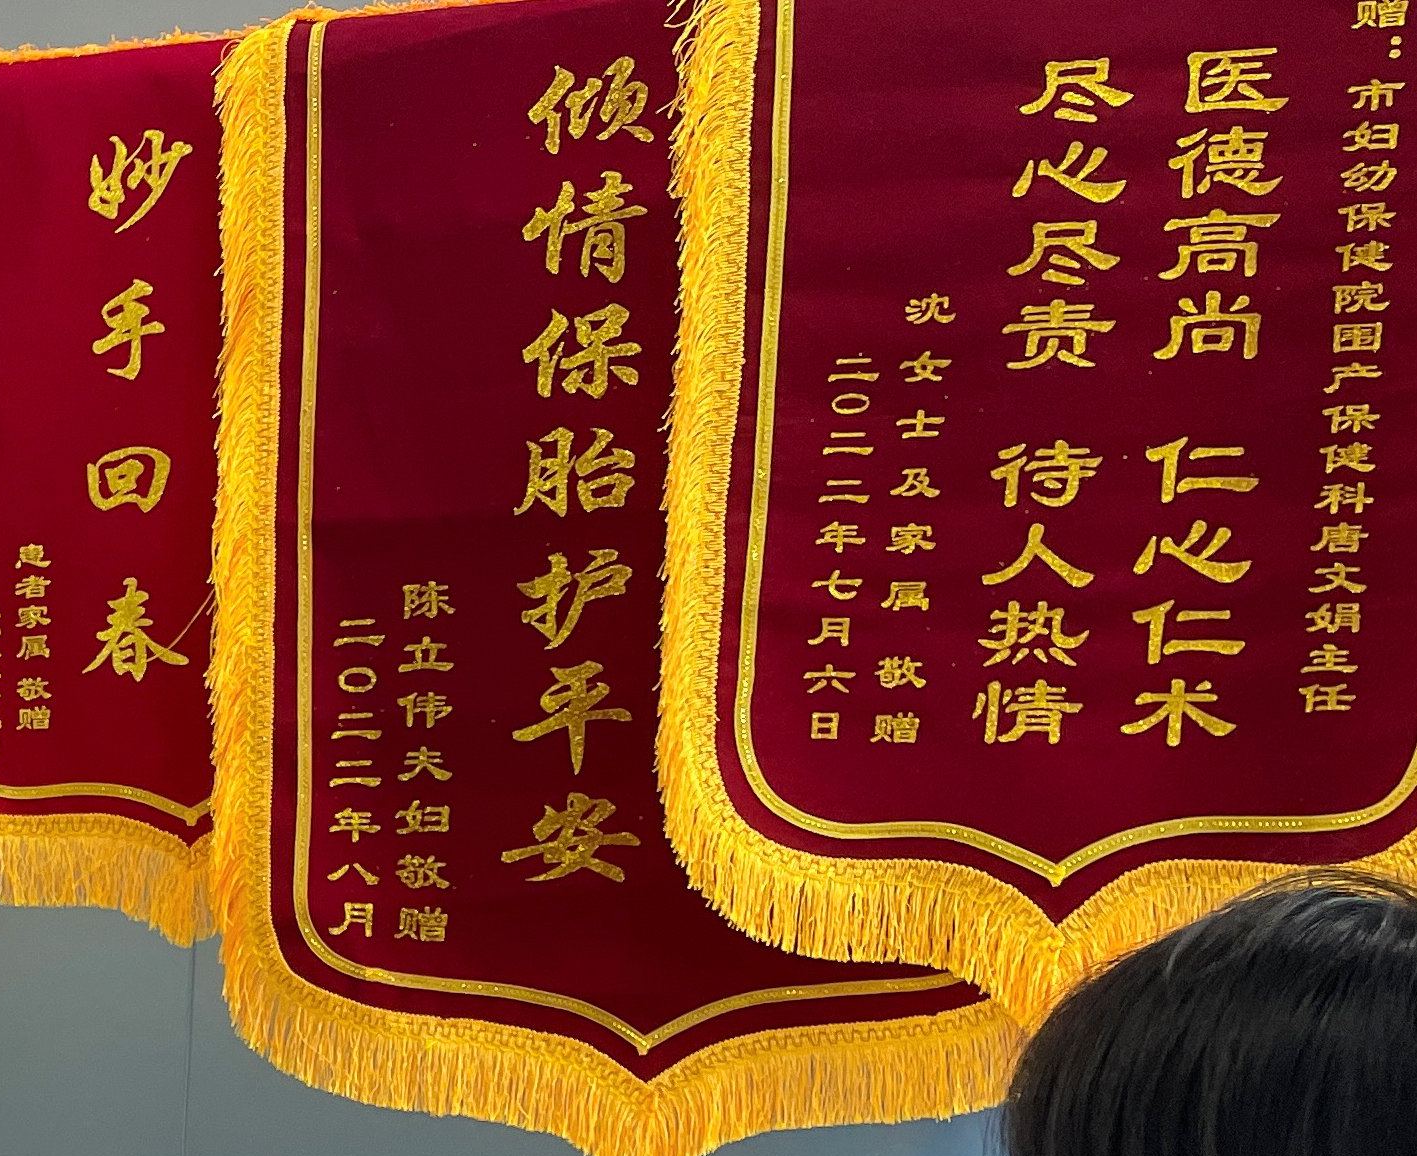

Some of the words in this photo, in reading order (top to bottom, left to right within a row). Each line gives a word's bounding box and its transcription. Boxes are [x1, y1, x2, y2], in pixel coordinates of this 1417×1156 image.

[1002, 58, 1135, 370] 尽心尽责
[1153, 48, 1290, 360] 医德高尚
[82, 129, 192, 682] 妙手回春
[501, 56, 655, 883] 倾情保胎护平安
[881, 293, 956, 612] 沈女士及家属
[15, 543, 52, 661] 患者家属
[15, 677, 52, 731] 敬赠
[870, 656, 926, 744] 敬赠
[972, 440, 1103, 745] 待人热情
[1120, 437, 1260, 747] 仁心仁术
[393, 580, 456, 943] 陈立伟夫妇敬赠
